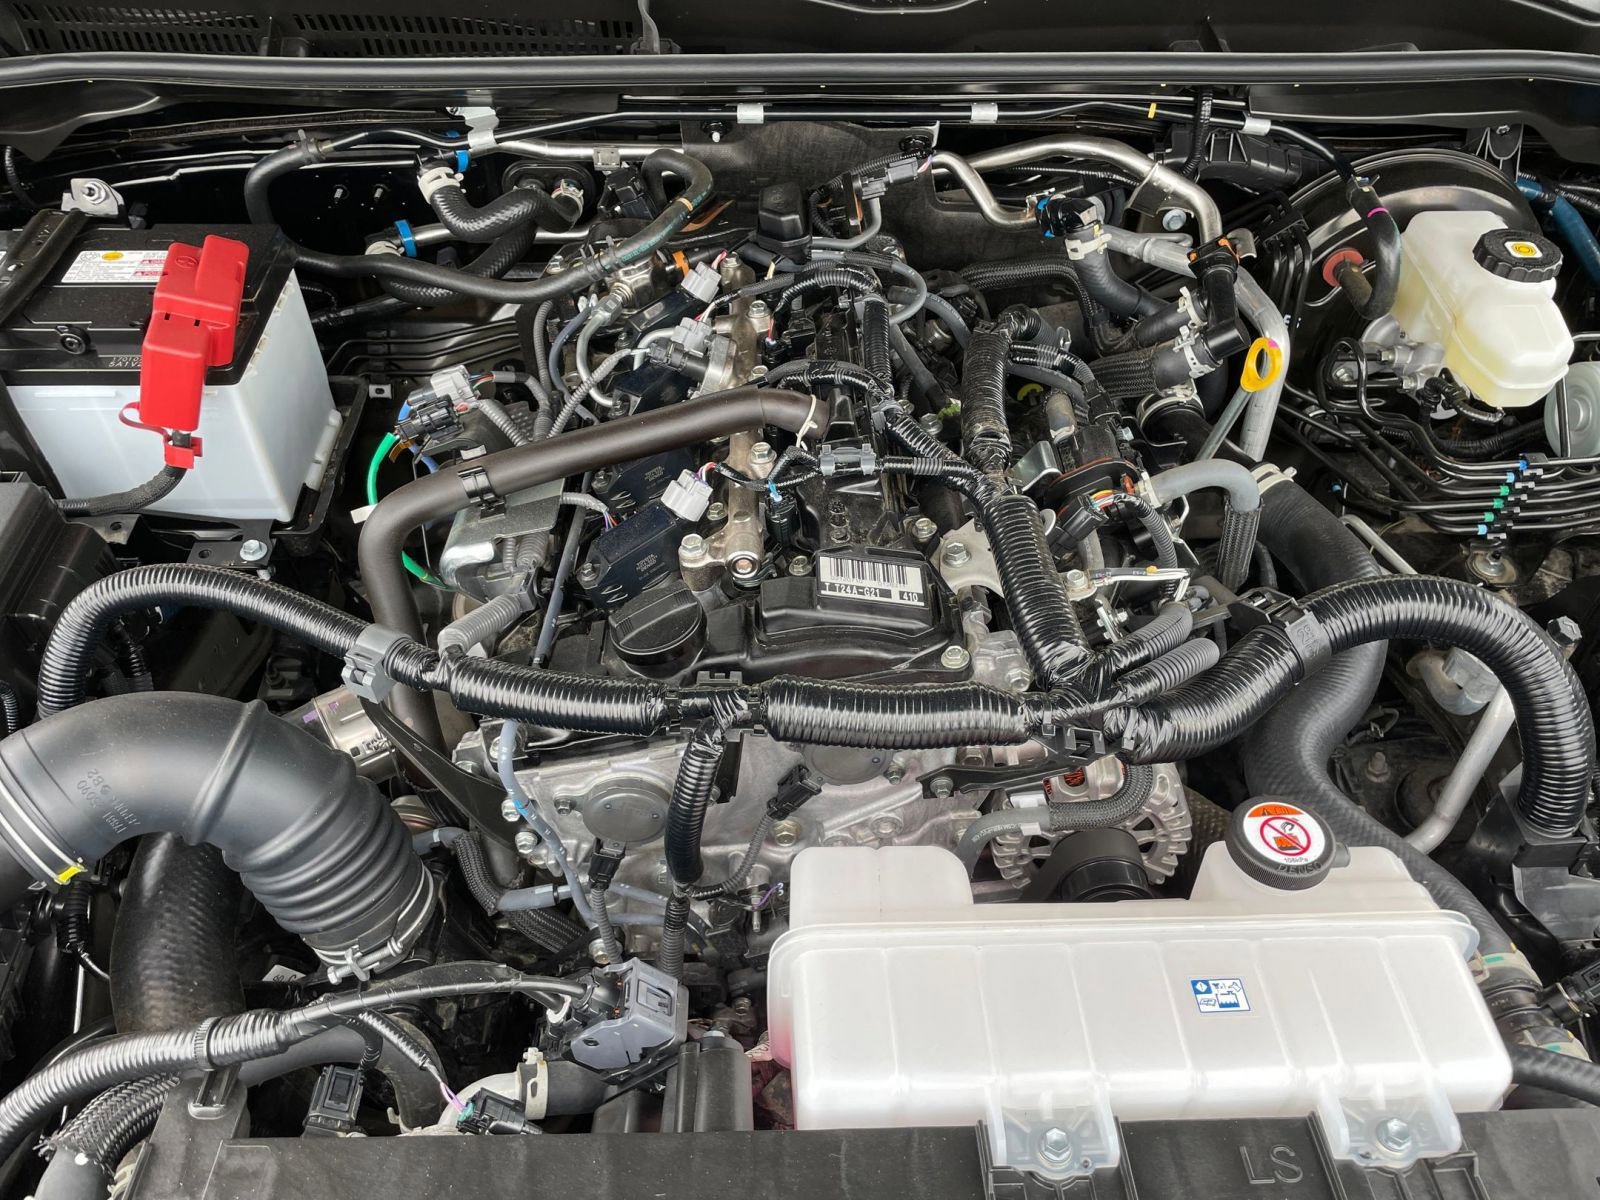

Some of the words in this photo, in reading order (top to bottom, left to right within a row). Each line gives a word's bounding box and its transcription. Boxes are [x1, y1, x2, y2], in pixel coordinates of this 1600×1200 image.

[834, 584, 880, 598] T24A-G21
[903, 592, 918, 602] 410
[1239, 1144, 1303, 1184] LS
